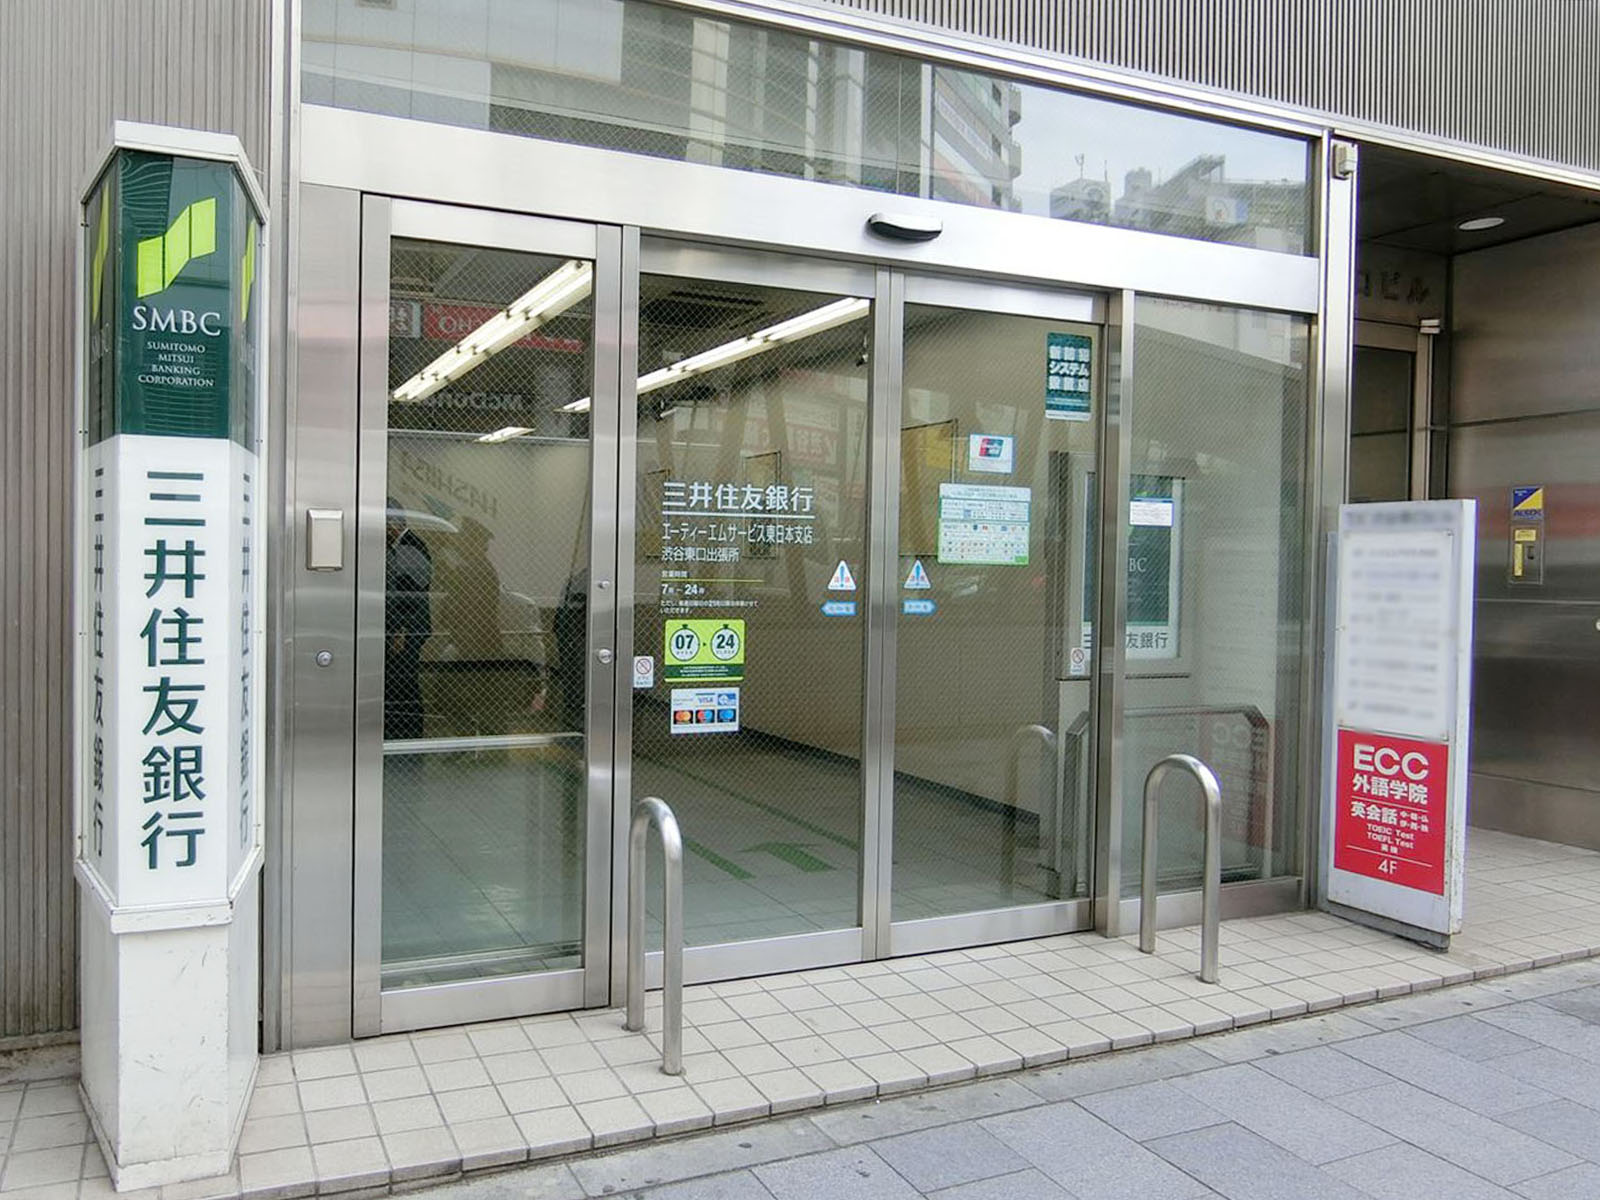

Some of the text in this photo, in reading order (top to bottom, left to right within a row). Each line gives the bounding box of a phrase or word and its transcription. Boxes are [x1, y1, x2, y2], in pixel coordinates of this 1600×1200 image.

[132, 305, 221, 336] SMBC
[147, 341, 206, 353] SUMITOMO
[158, 354, 194, 363] MITSUI
[151, 364, 201, 376] BANKING
[1049, 360, 1090, 377] システム
[138, 374, 215, 387] CORPORATION
[662, 481, 814, 512] 三井住友銀行
[661, 522, 814, 545] エーティーエムサービス東日本支店
[661, 546, 740, 562] 渋谷東口出張所
[675, 634, 735, 650] 07 24
[140, 471, 206, 870] 三井住友銀行
[1353, 743, 1429, 780] ECC
[1352, 773, 1428, 805] 外語学院
[1351, 801, 1398, 825] 英会話
[1366, 823, 1415, 841] TOEIC Test
[1366, 831, 1415, 849] TOEFL Test
[1378, 859, 1398, 875] 4F
